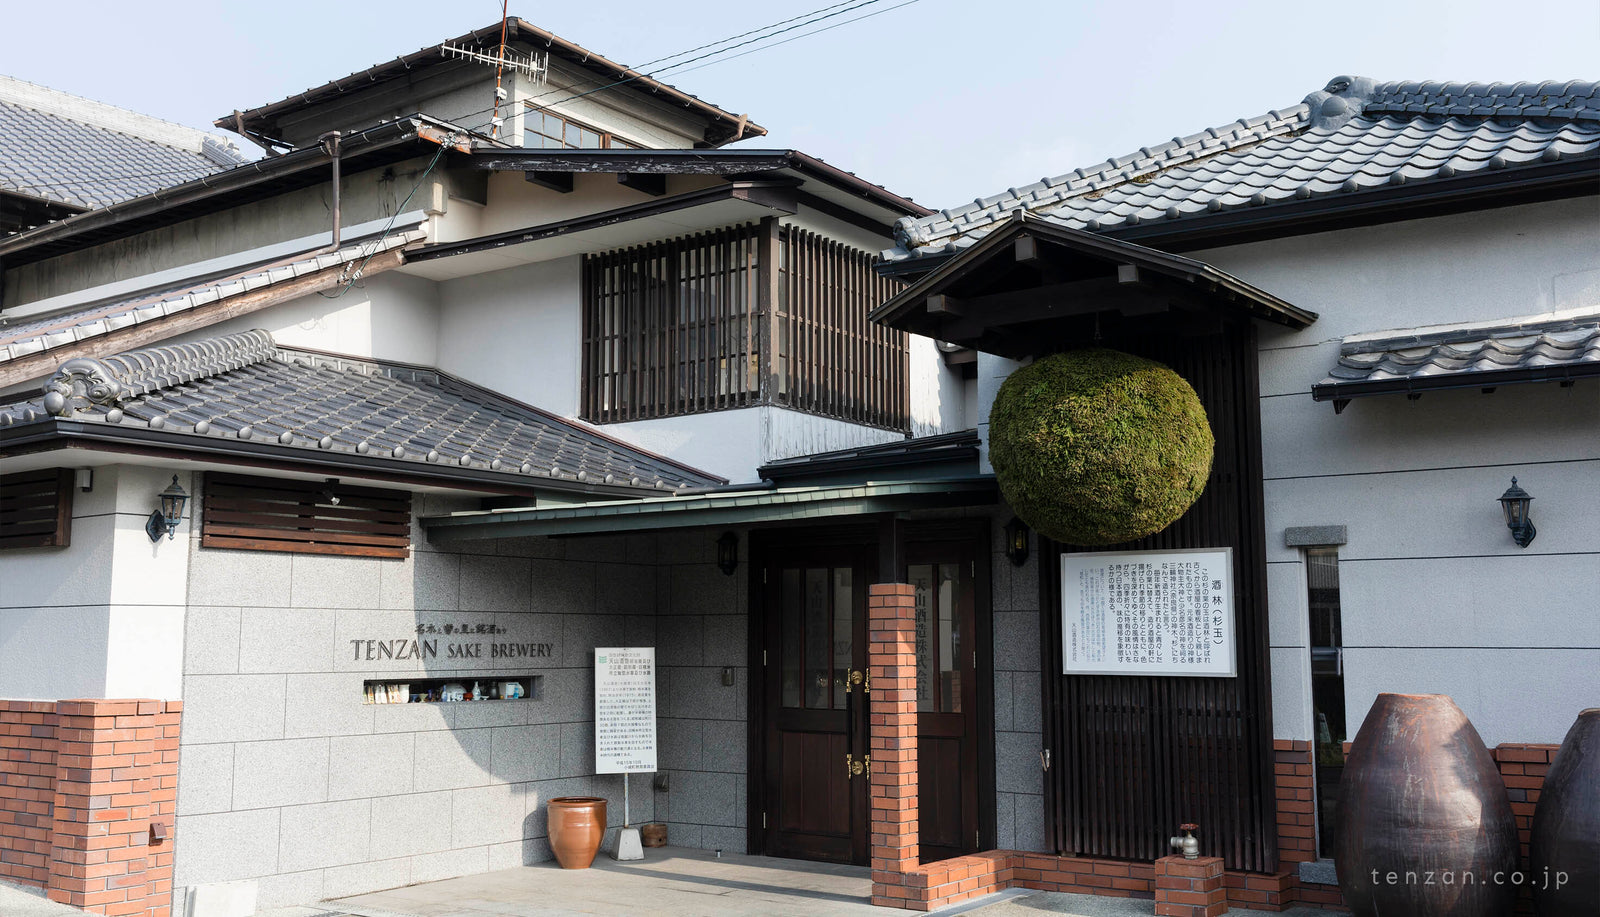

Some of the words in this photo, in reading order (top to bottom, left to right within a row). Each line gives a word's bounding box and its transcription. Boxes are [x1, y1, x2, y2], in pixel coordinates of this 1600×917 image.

[350, 639, 437, 661] TENZAN
[447, 643, 482, 658] SAKE
[491, 643, 554, 658] BREWERY
